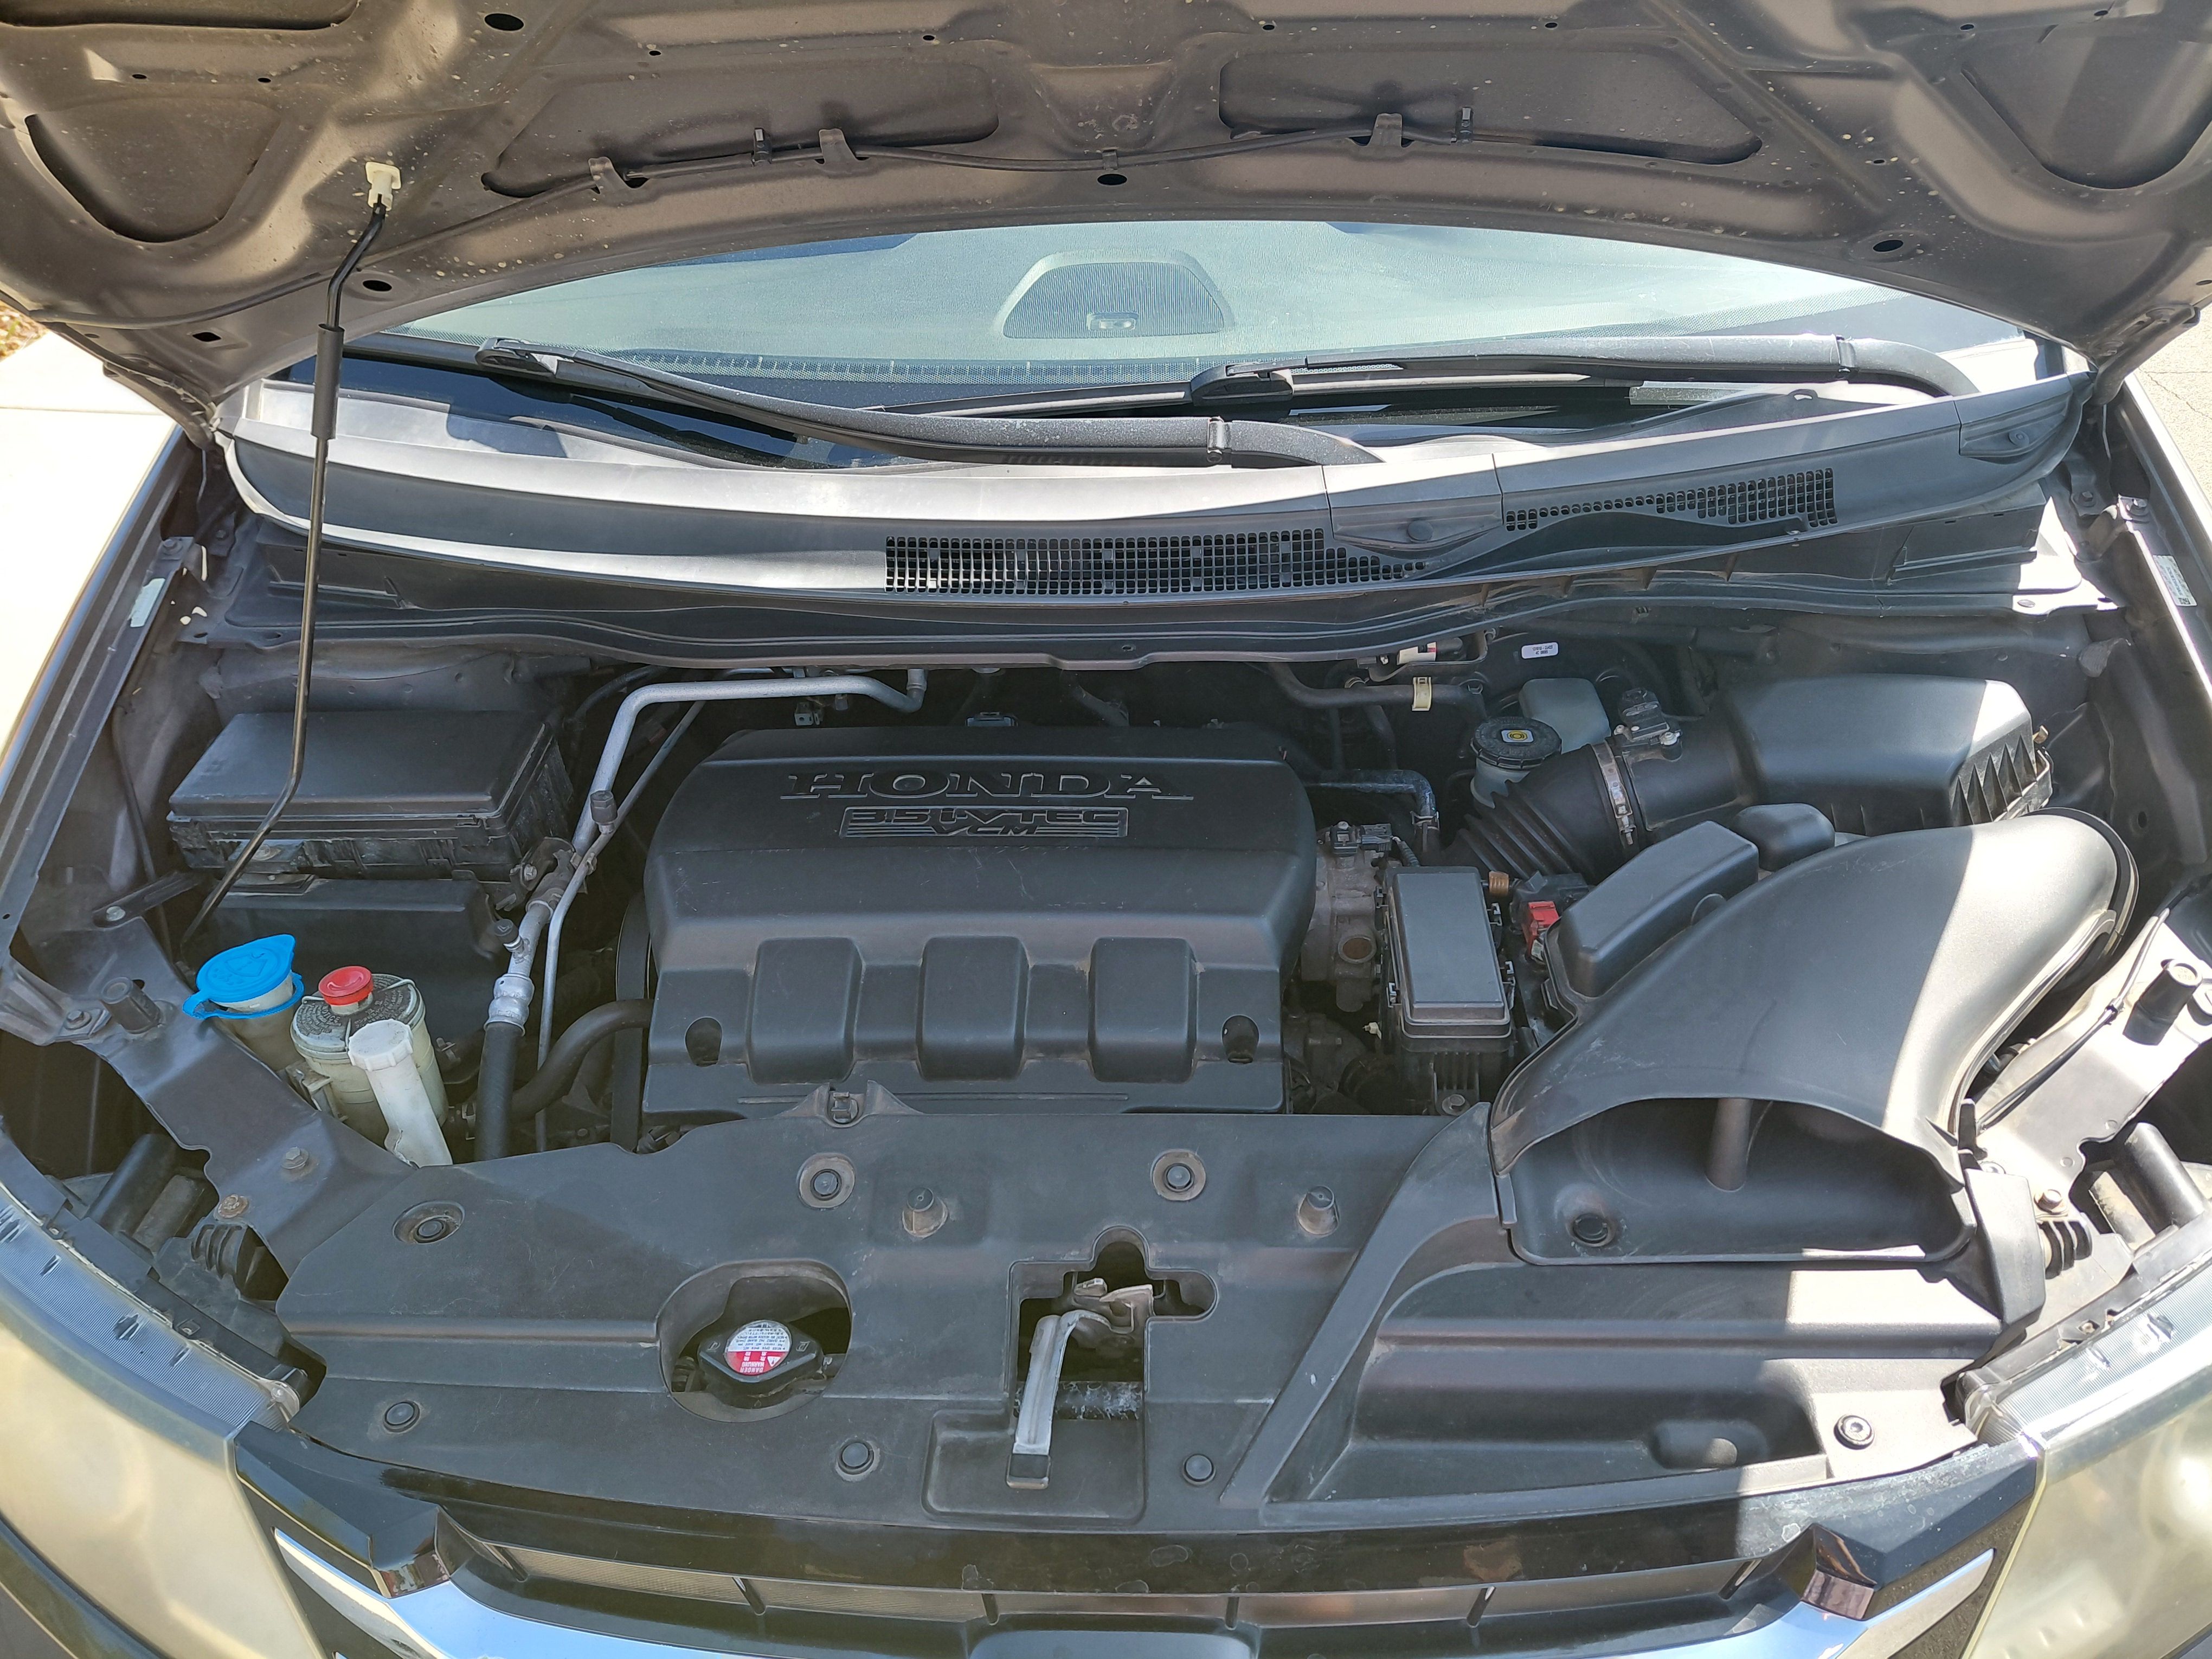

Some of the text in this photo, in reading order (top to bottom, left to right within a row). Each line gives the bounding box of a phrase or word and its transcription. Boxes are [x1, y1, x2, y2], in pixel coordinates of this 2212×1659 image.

[780, 773, 1193, 800] HONDA
[940, 807, 1121, 825] i-VTEC
[934, 825, 1039, 837] VCM
[321, 1003, 341, 1023] NOTICE
